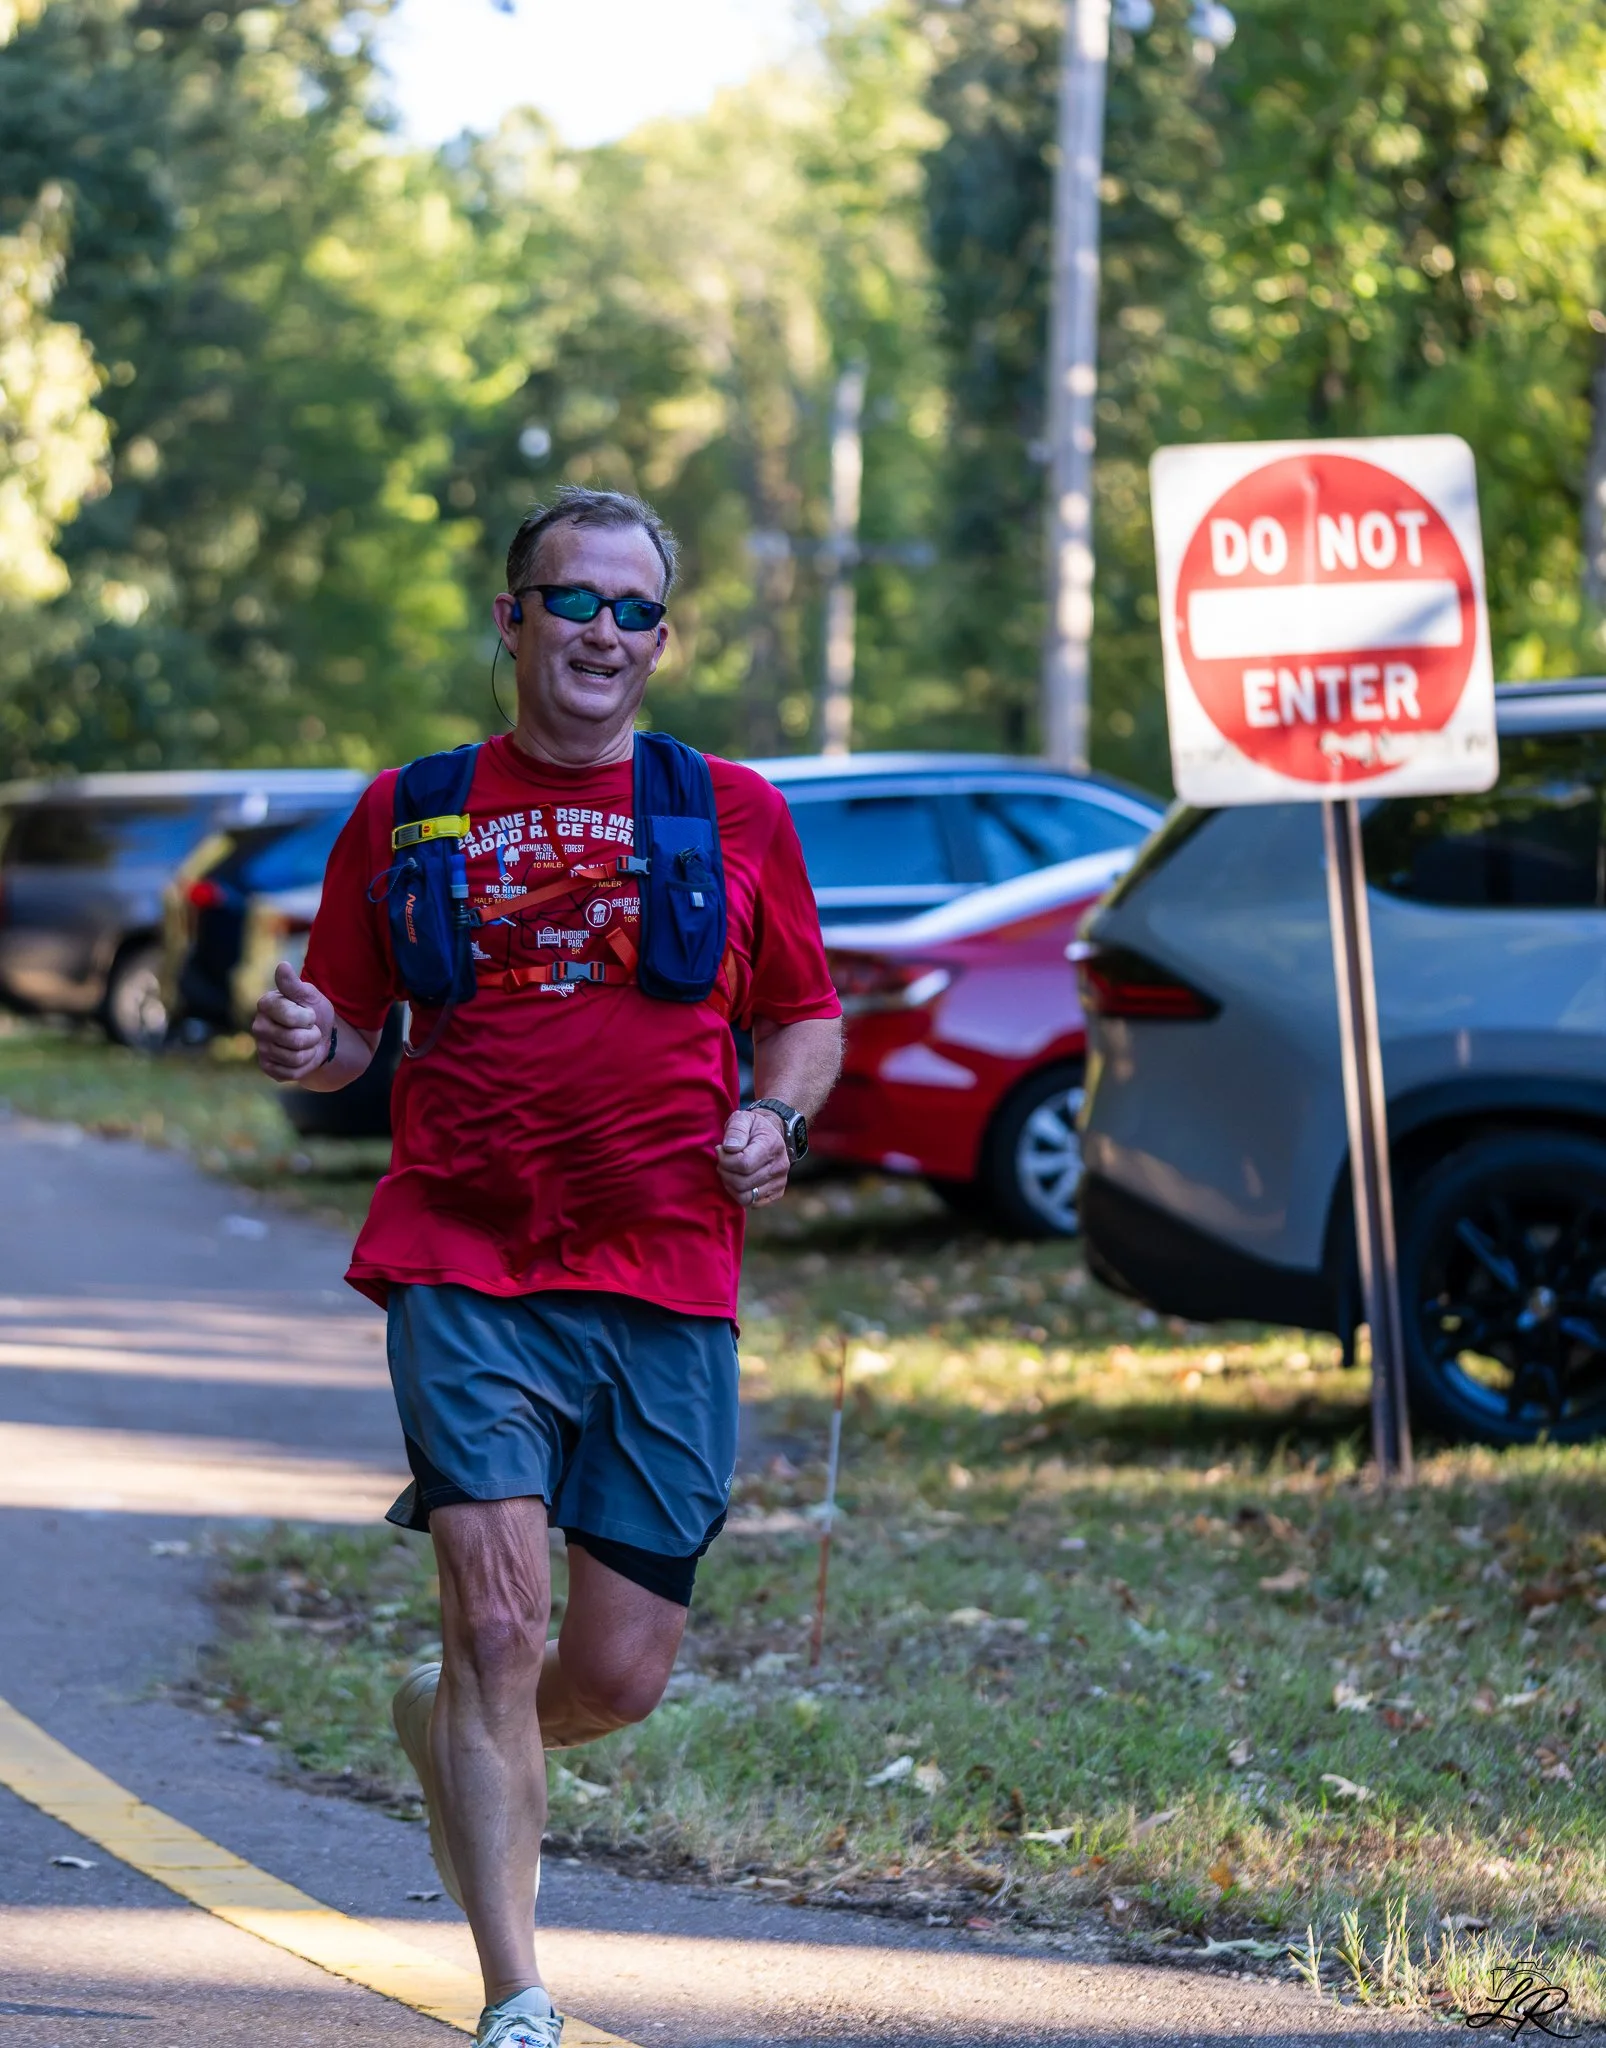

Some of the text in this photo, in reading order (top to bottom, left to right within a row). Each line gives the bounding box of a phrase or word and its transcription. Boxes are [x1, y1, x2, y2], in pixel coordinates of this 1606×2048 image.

[1209, 510, 1428, 576] DO NOT
[1242, 663, 1421, 728] ENTER
[478, 813, 526, 839] LANE
[531, 808, 604, 824] PRSER
[468, 828, 523, 858] ROAD
[564, 844, 585, 853] FOREST
[535, 852, 552, 861] STATE
[533, 861, 542, 869] 10
[486, 885, 528, 895] BIG RIVER
[473, 897, 493, 905] HALF
[611, 897, 633, 908] SHELBY
[623, 905, 640, 915] PARK
[623, 915, 638, 923] 10K
[567, 939, 584, 948] PARK
[571, 947, 581, 955] 5K
